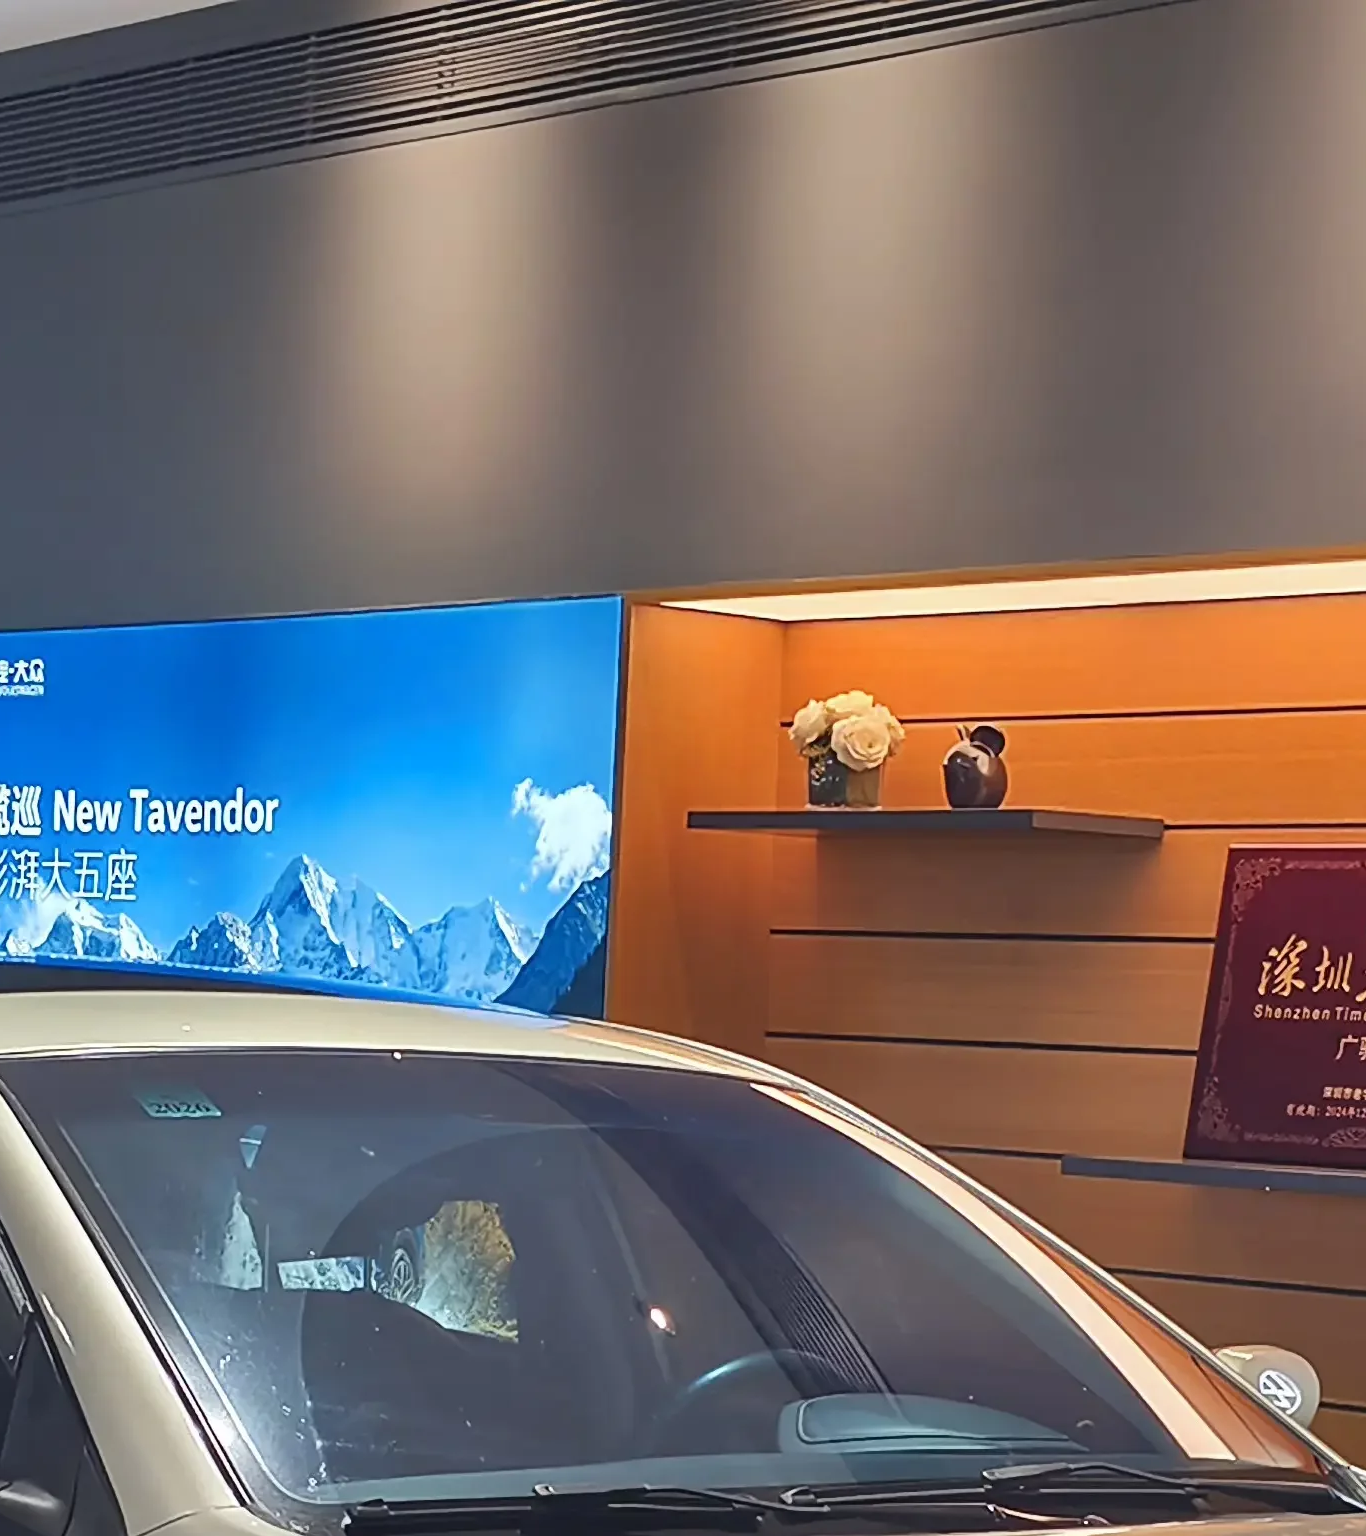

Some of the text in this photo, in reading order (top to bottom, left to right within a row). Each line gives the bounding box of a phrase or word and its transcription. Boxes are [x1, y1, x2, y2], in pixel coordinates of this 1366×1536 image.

[52, 787, 280, 834] New Tavendor
[1252, 1003, 1331, 1021] Shenzhen
